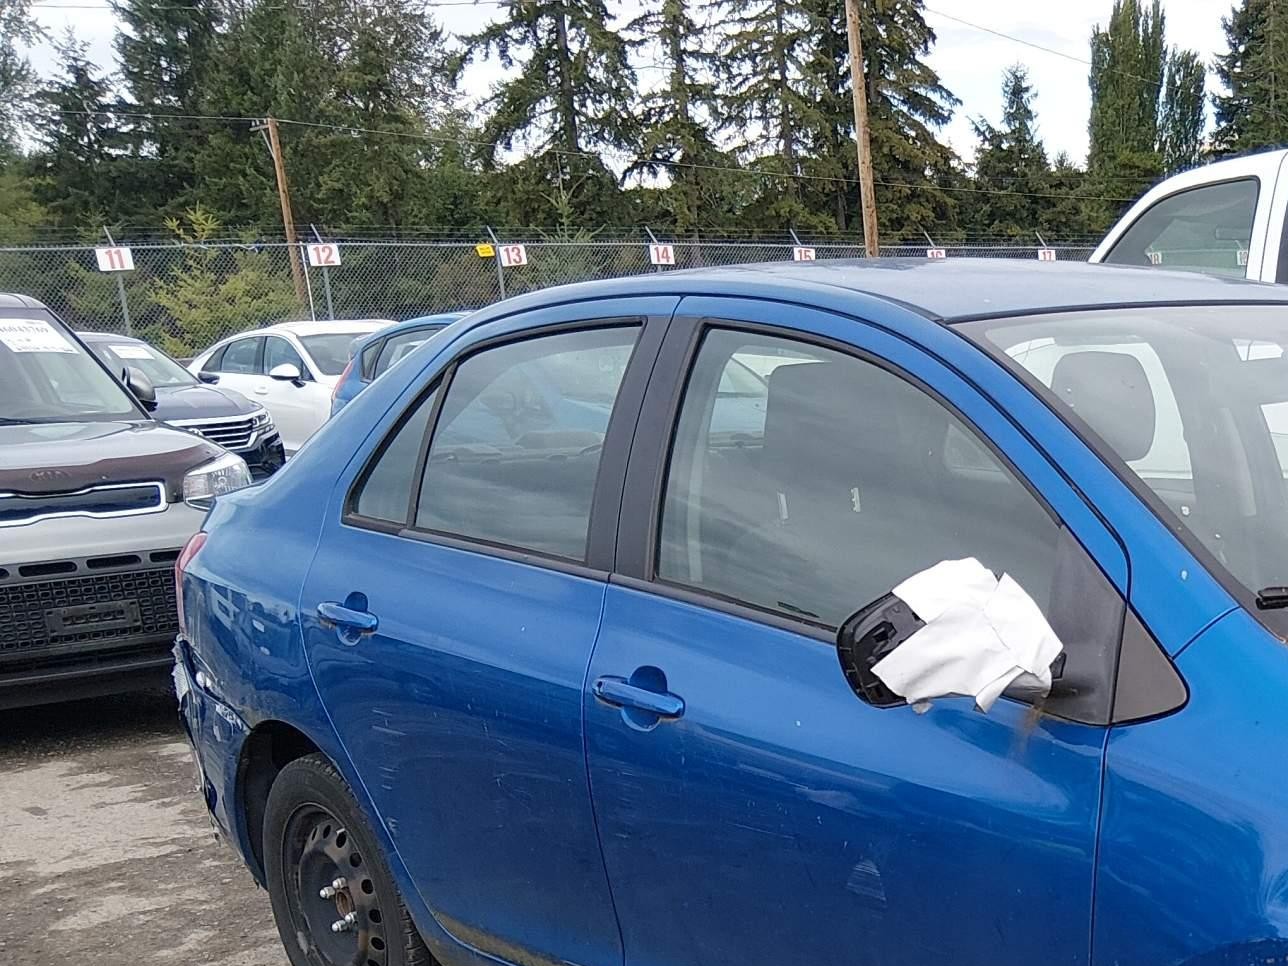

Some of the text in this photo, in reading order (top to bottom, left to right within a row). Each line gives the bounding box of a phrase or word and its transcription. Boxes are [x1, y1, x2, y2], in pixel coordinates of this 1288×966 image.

[104, 249, 126, 270] 11
[312, 245, 336, 265] 12
[503, 246, 523, 265] 13
[654, 246, 671, 263] 14
